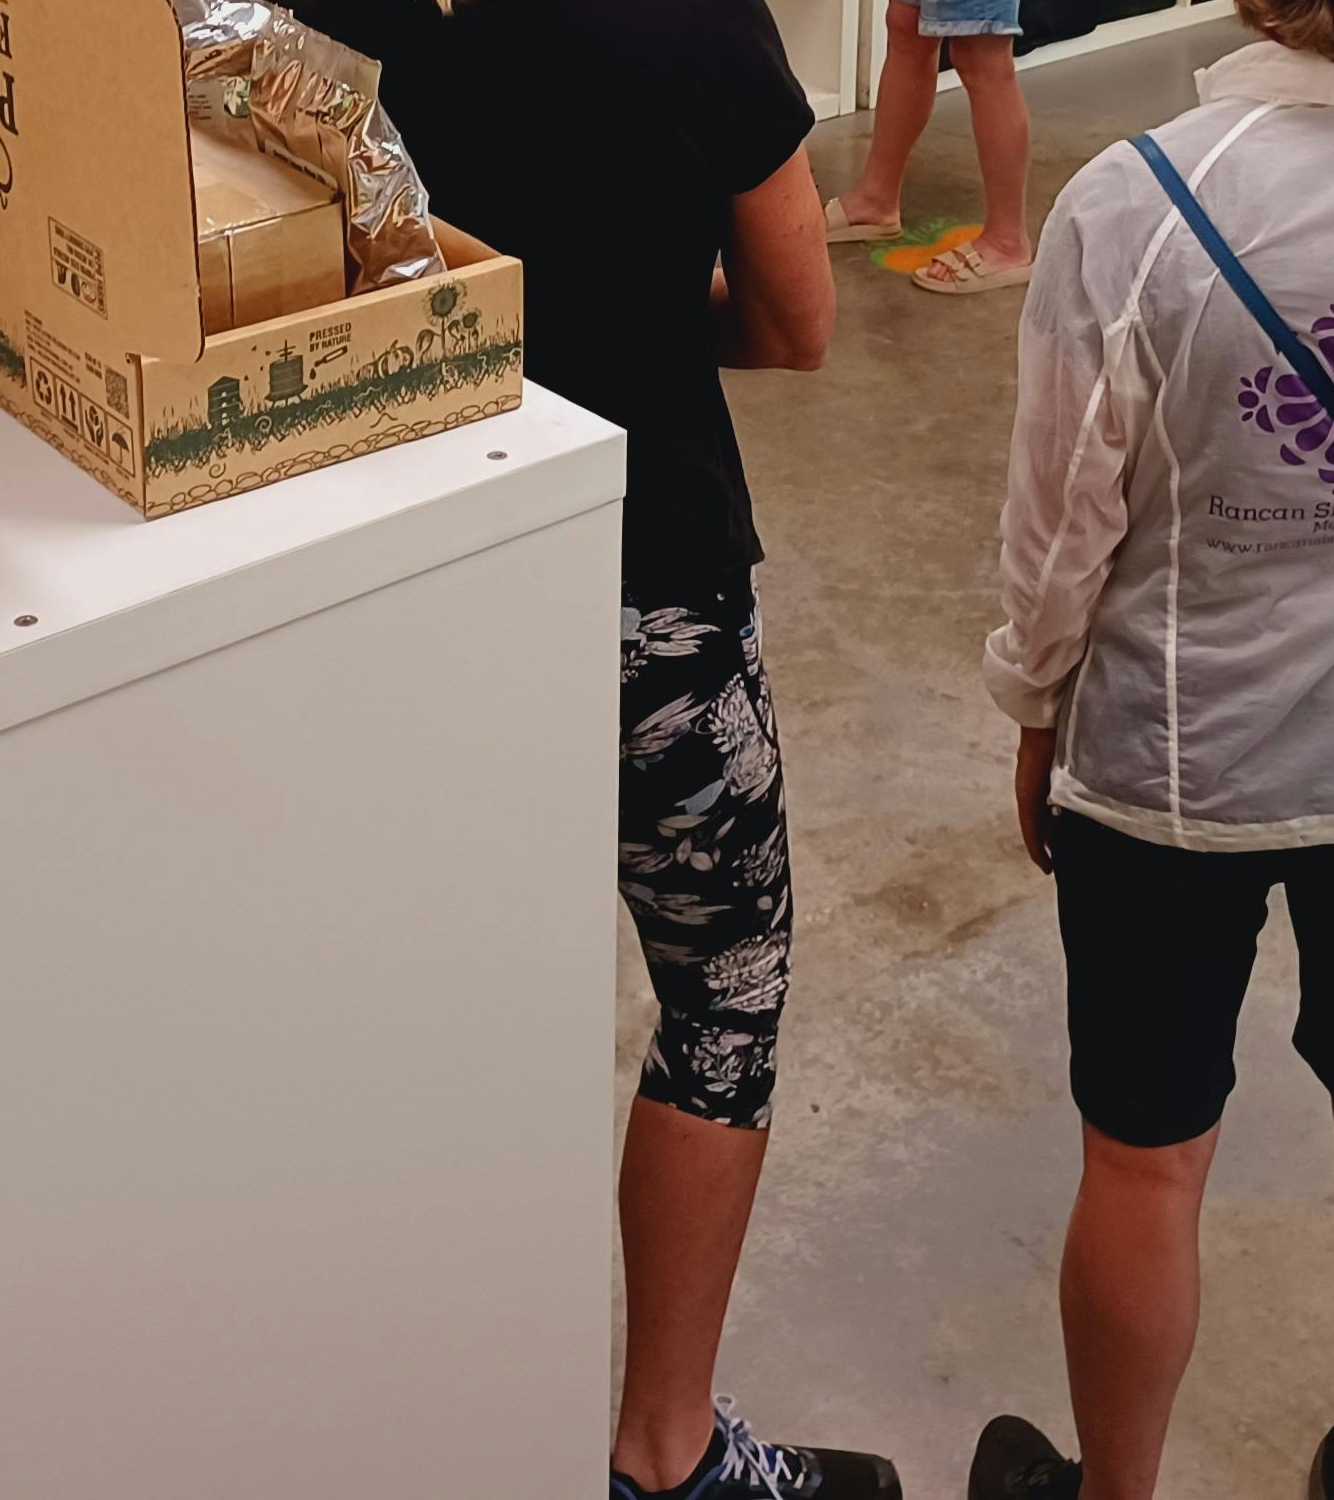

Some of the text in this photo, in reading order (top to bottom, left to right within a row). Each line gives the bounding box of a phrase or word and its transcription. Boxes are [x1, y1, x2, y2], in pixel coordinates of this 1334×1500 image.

[309, 322, 352, 342] PRESSED
[309, 333, 352, 353] BY NATURE
[1208, 495, 1306, 521] Rancan
